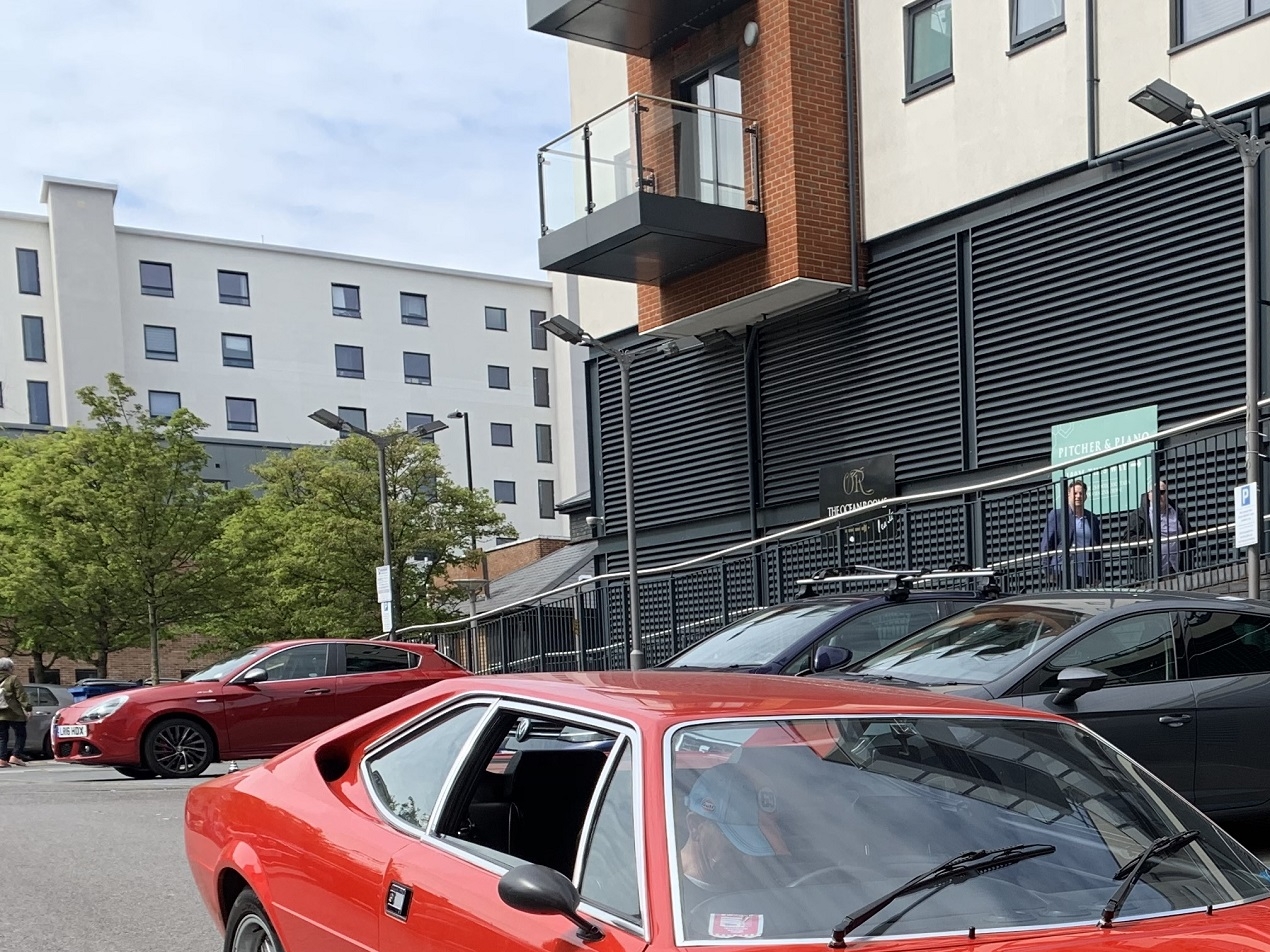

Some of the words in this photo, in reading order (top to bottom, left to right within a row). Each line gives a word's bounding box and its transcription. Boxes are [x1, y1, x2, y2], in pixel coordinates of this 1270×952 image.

[1058, 440, 1102, 459] PITCHER
[1104, 438, 1112, 451] &
[1114, 431, 1150, 448] PIANO
[1242, 488, 1249, 505] P
